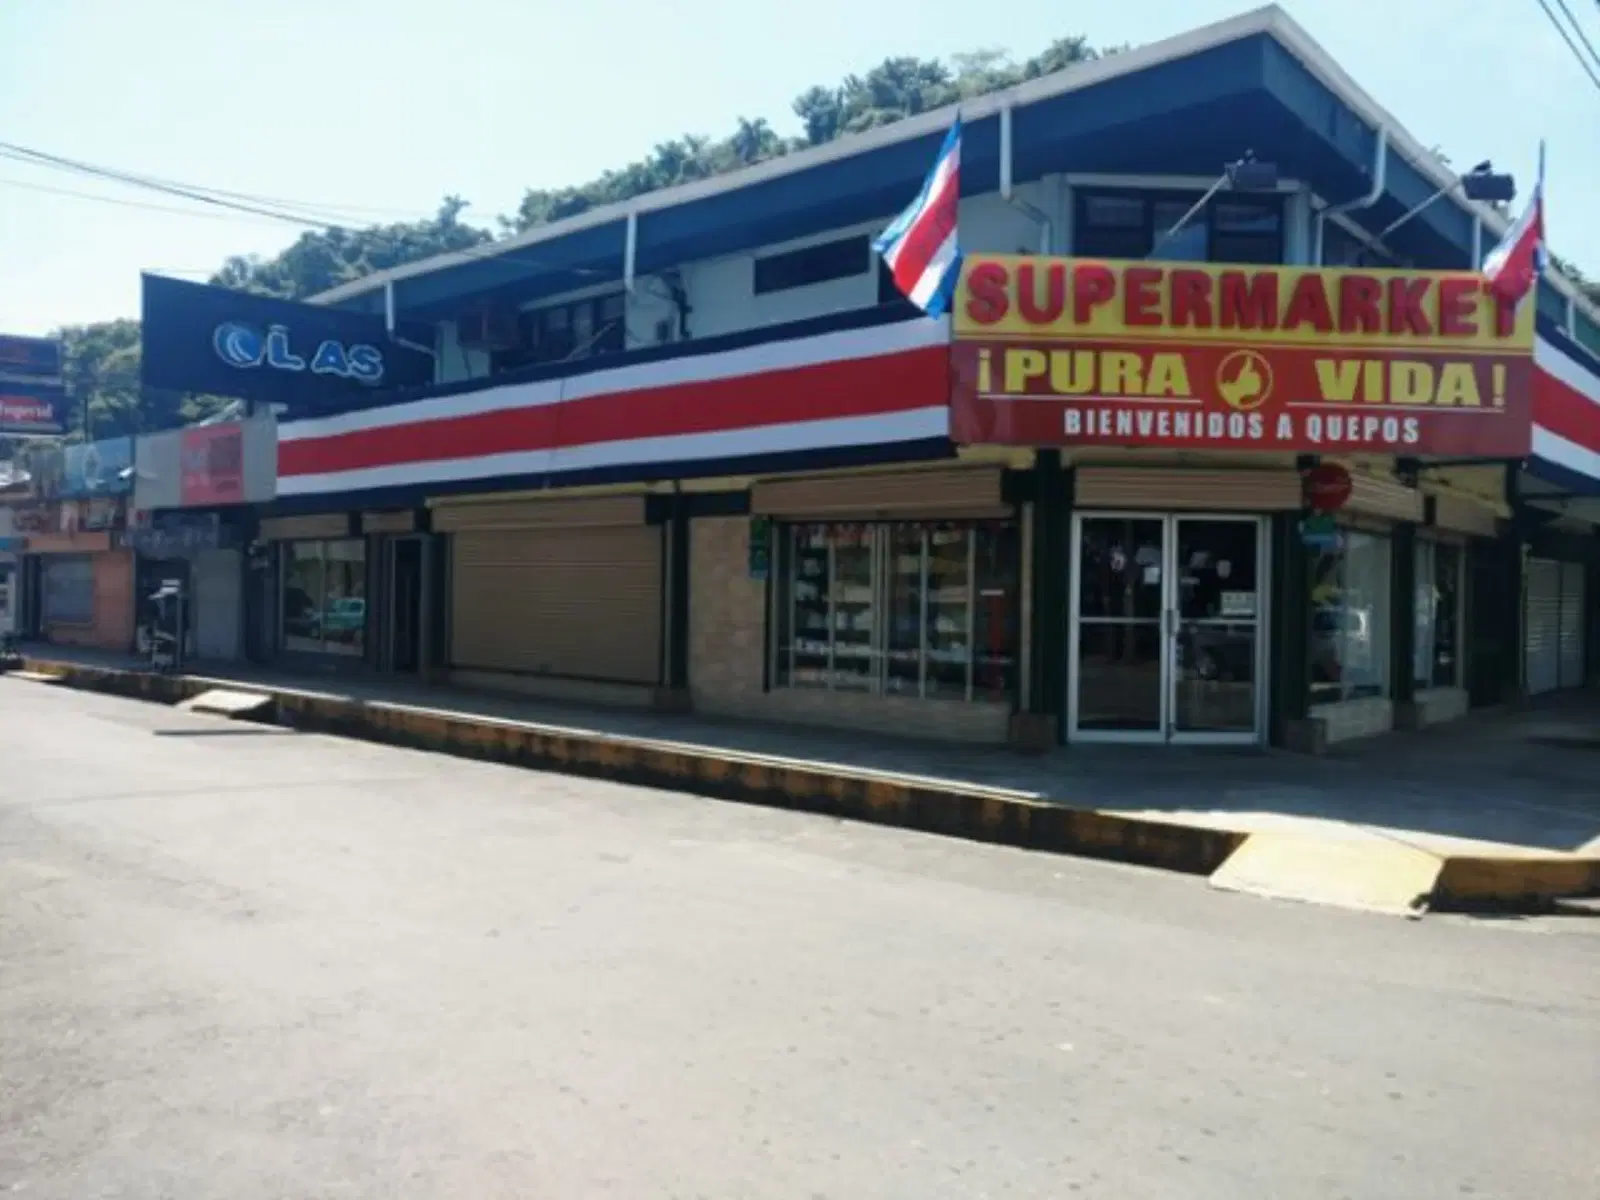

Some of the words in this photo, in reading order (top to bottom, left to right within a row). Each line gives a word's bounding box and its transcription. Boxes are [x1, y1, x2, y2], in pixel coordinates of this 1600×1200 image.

[965, 260, 1519, 338] SUPERMARKET
[1315, 359, 1506, 407] VIDA!
[1064, 408, 1264, 440] BIENVENIDOS
[1276, 412, 1293, 440] A
[1306, 414, 1420, 444] QUEPOS
